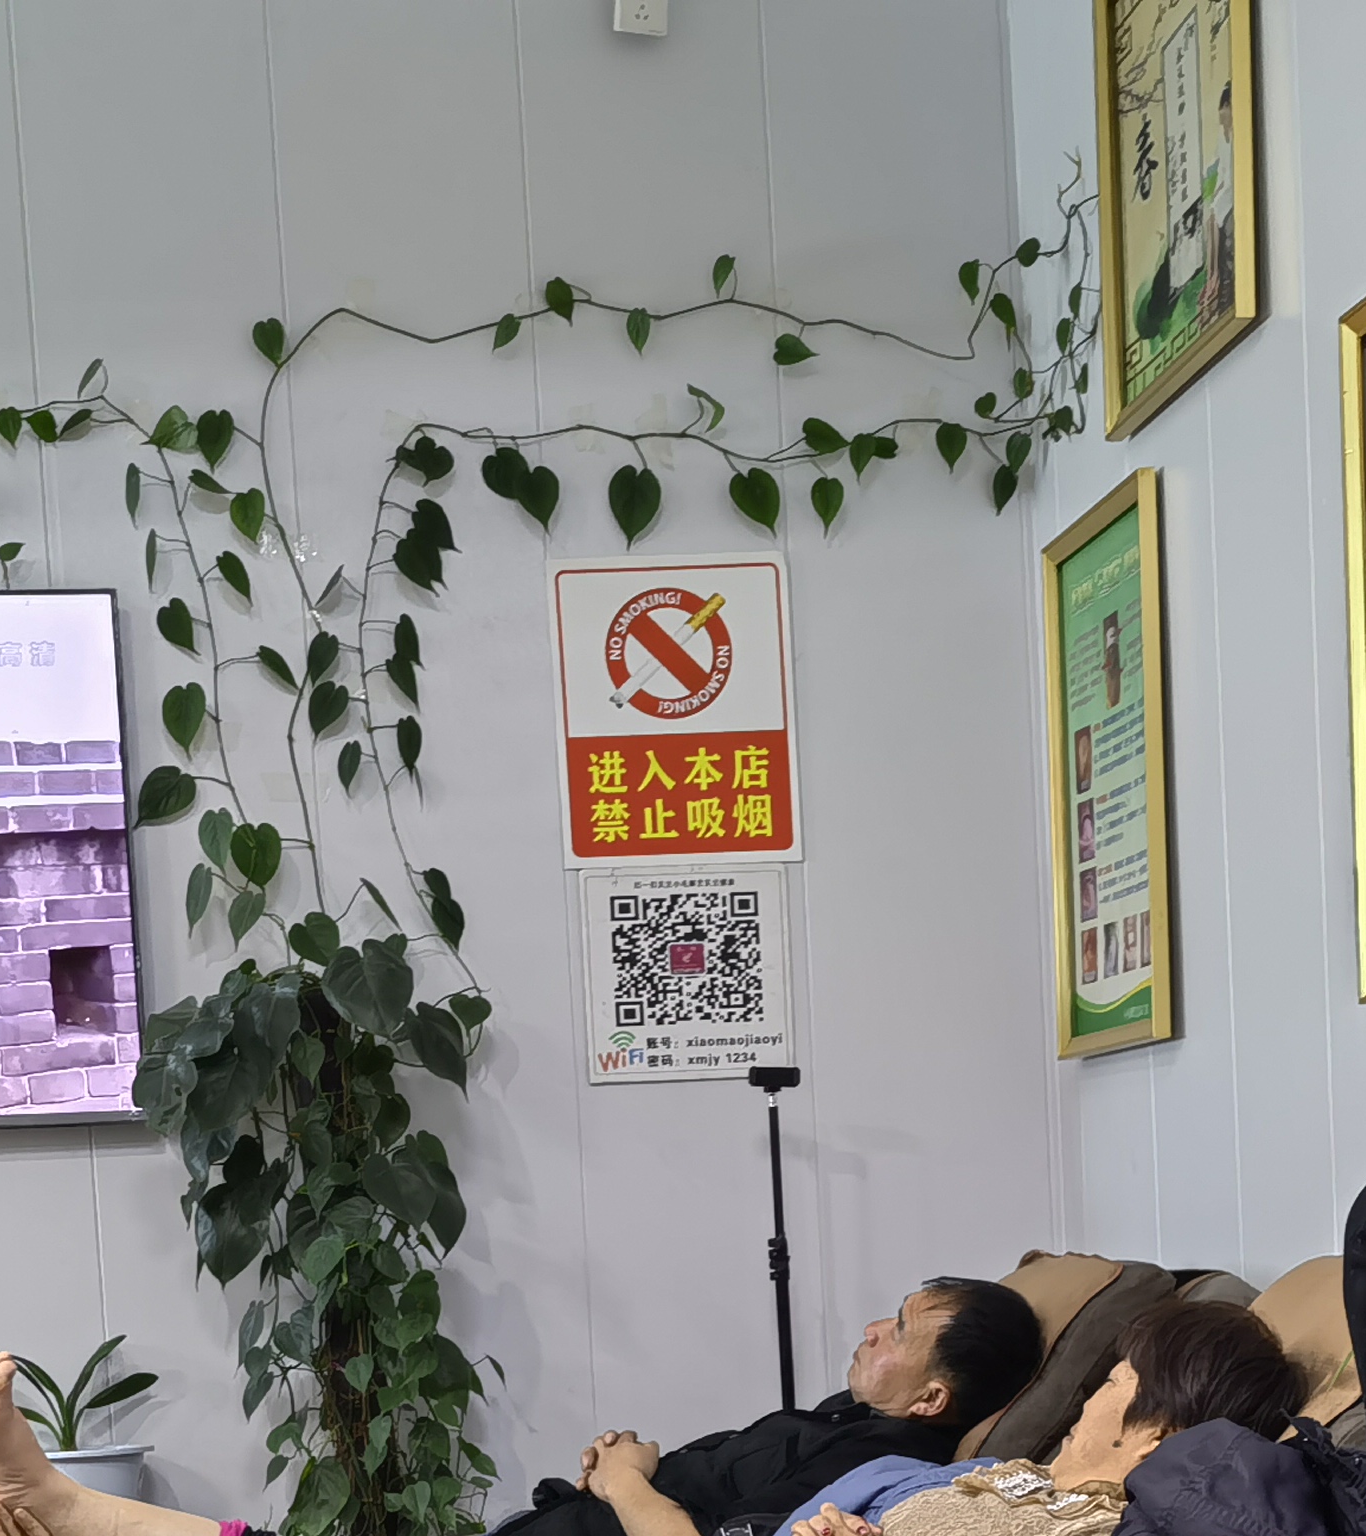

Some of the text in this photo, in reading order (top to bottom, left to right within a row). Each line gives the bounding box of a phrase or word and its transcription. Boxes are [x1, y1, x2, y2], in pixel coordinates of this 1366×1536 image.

[608, 591, 683, 661] NO SMOKING!
[657, 645, 731, 715] NO SMOKING!
[587, 744, 771, 794] 进入本店
[590, 794, 773, 843] 禁止吸烟
[597, 1046, 645, 1073] WiFi
[686, 1032, 784, 1049] xiaomaojiaoyi
[687, 1054, 721, 1068] xmjy
[725, 1052, 758, 1064] 1234
